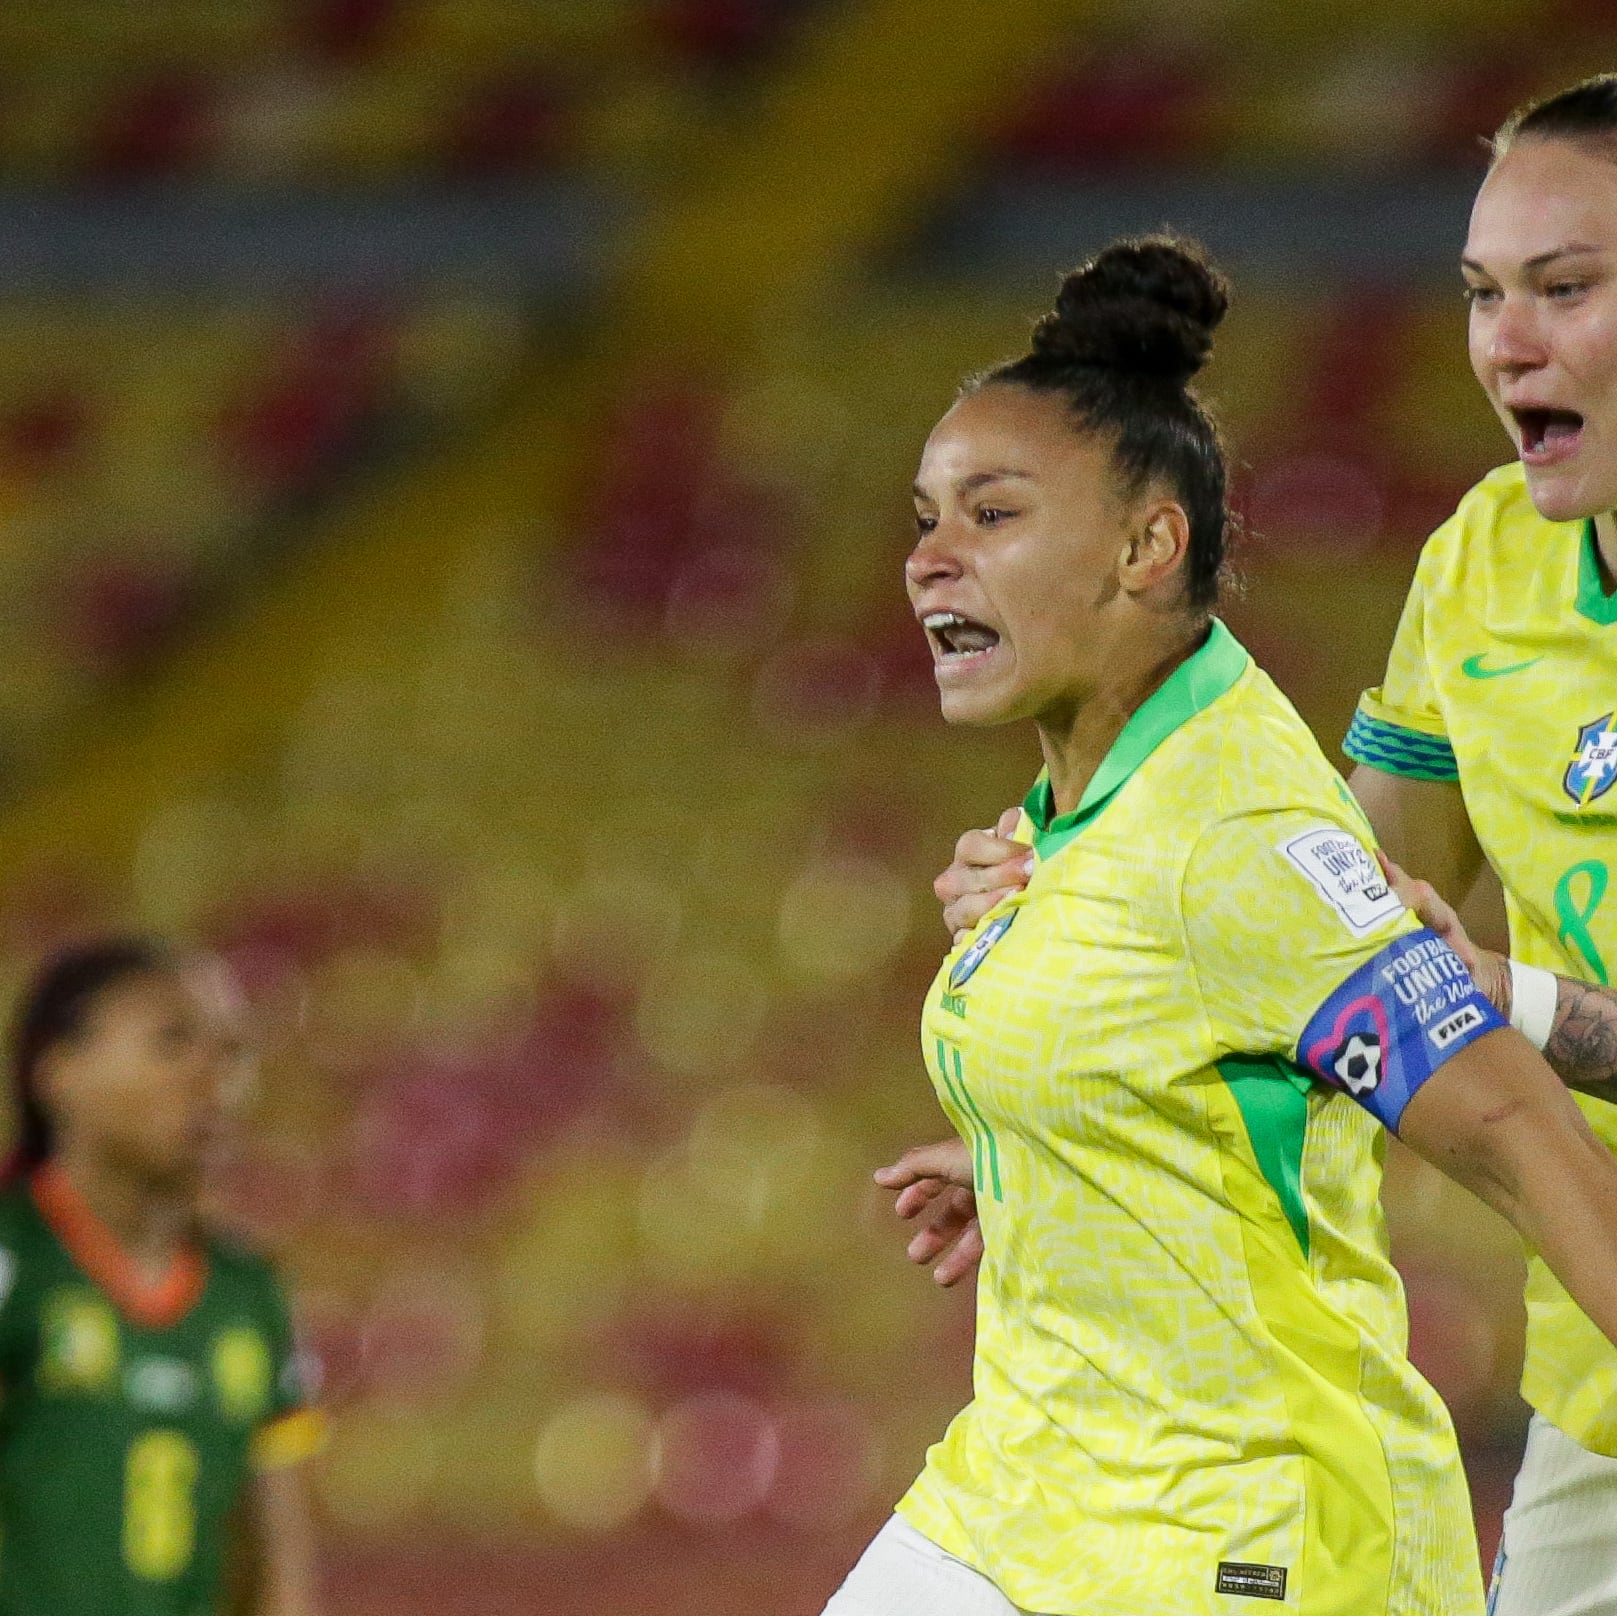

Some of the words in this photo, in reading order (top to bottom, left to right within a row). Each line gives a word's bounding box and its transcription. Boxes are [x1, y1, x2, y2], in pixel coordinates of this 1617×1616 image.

[1588, 748, 1614, 760] CBF
[1381, 937, 1453, 984] FOOTBA
[1394, 952, 1469, 1005] UNITE
[1437, 1011, 1477, 1040] FIFA
[936, 1038, 1003, 1203] 11
